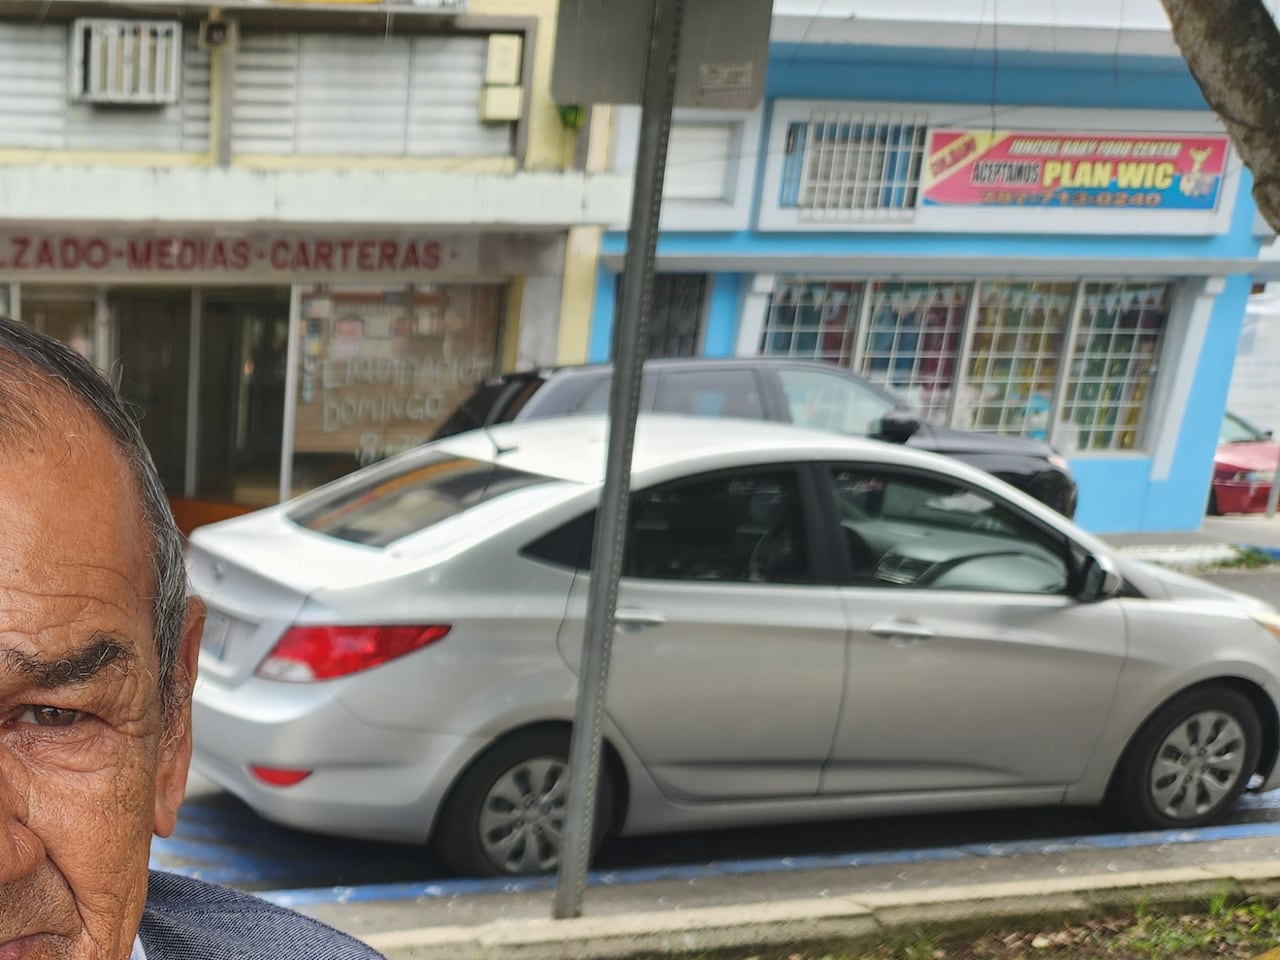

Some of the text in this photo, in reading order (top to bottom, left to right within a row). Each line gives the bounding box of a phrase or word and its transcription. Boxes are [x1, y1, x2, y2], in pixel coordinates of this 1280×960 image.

[973, 160, 1175, 189] ACEPTAMOS PLAN WIC
[125, 238, 250, 270] MEDIAS
[269, 240, 442, 272] CARTERAS
